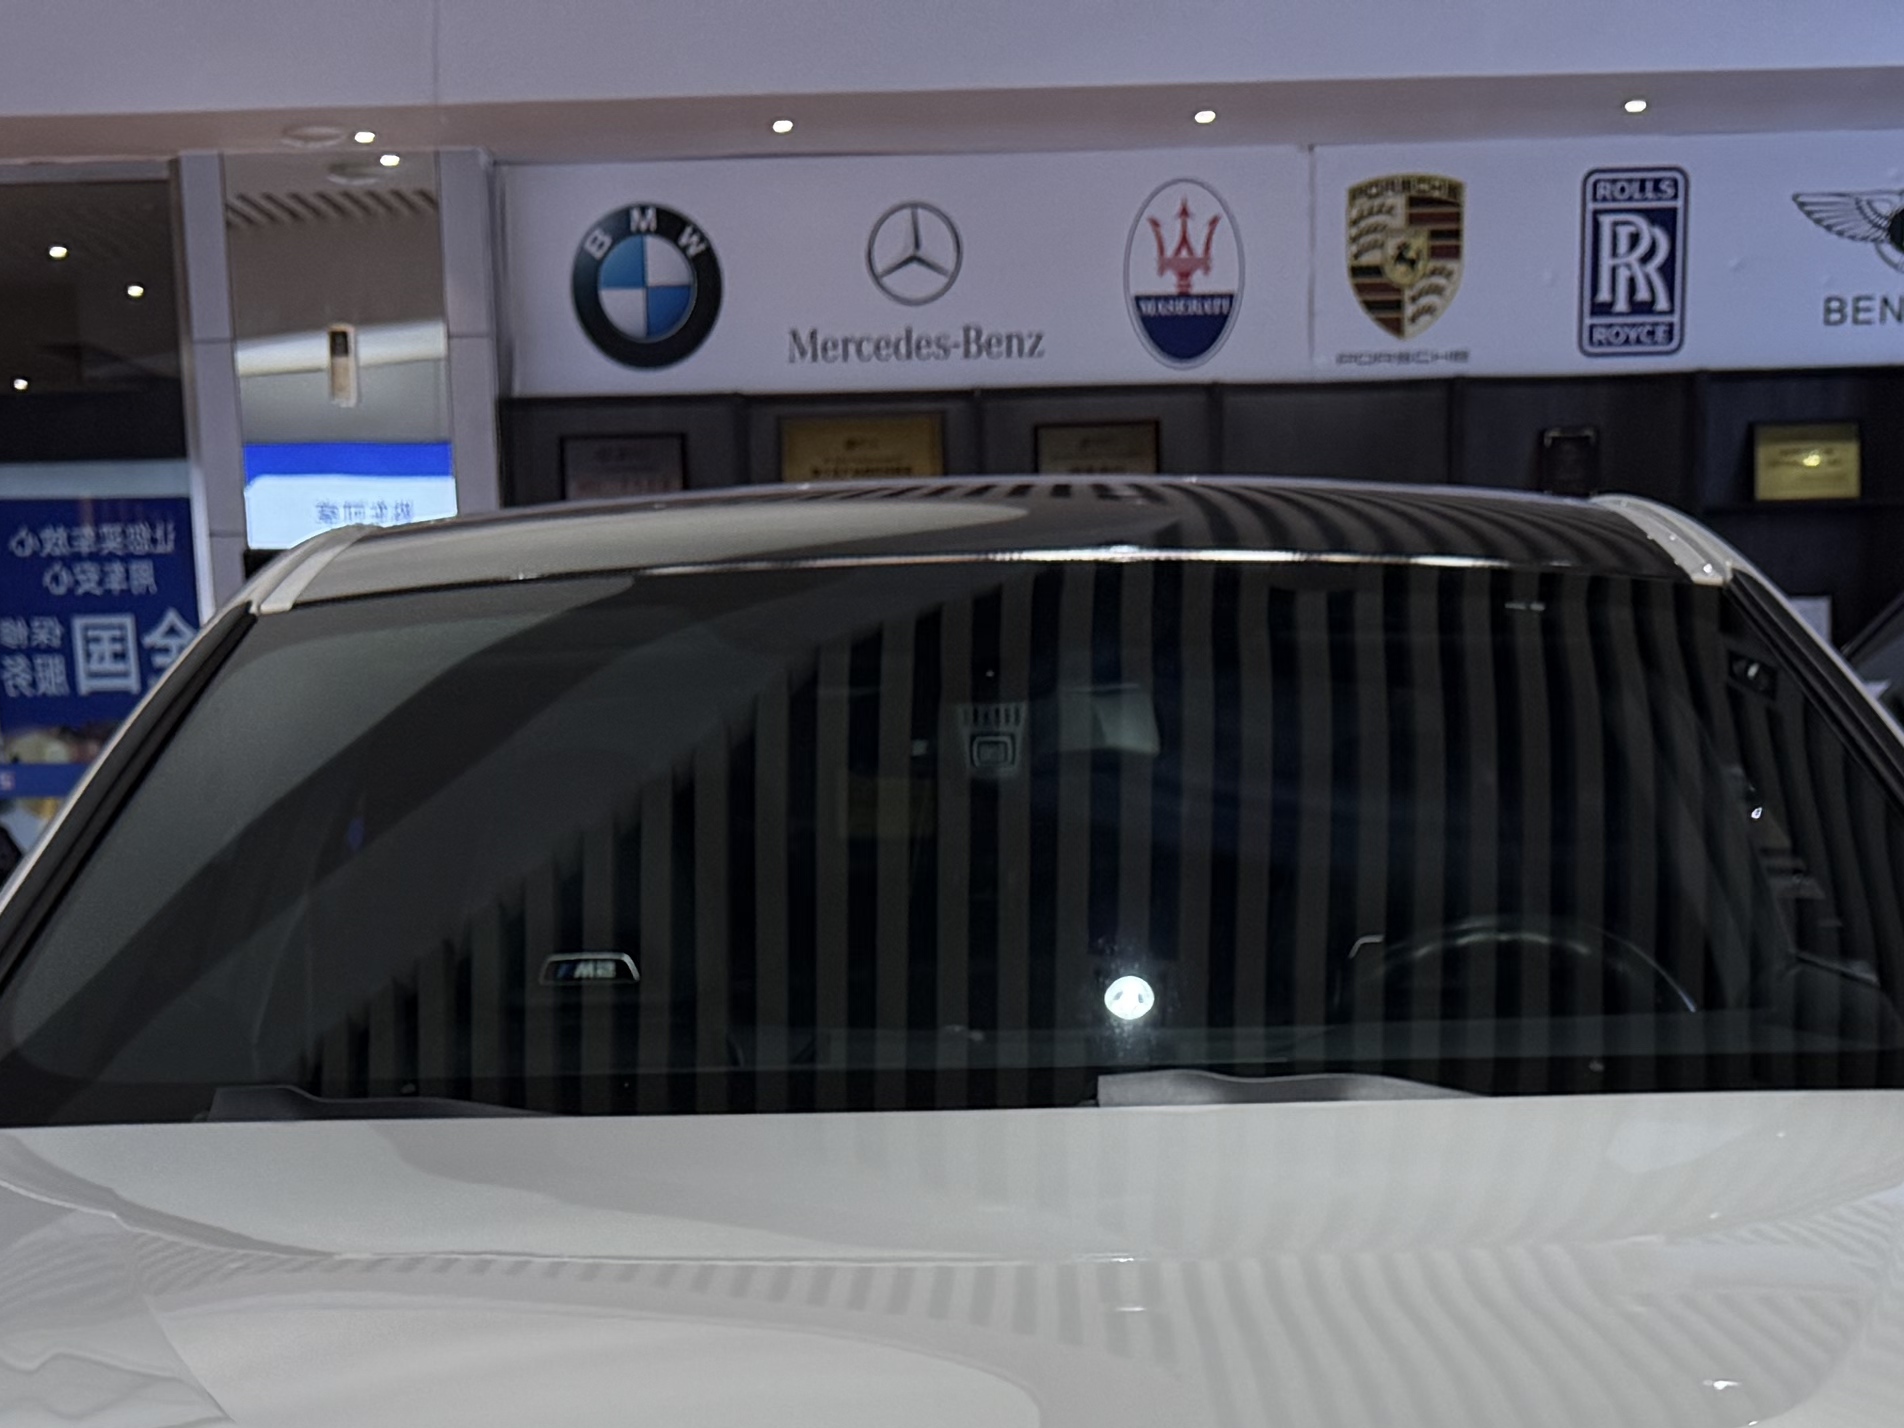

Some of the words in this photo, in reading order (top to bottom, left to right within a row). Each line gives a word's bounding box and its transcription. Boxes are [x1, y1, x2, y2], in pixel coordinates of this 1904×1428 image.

[1595, 177, 1677, 201] ROLLS
[584, 205, 708, 262] BMW
[787, 326, 1045, 365] Mercedes-Benz
[1592, 323, 1672, 347] ROYCE
